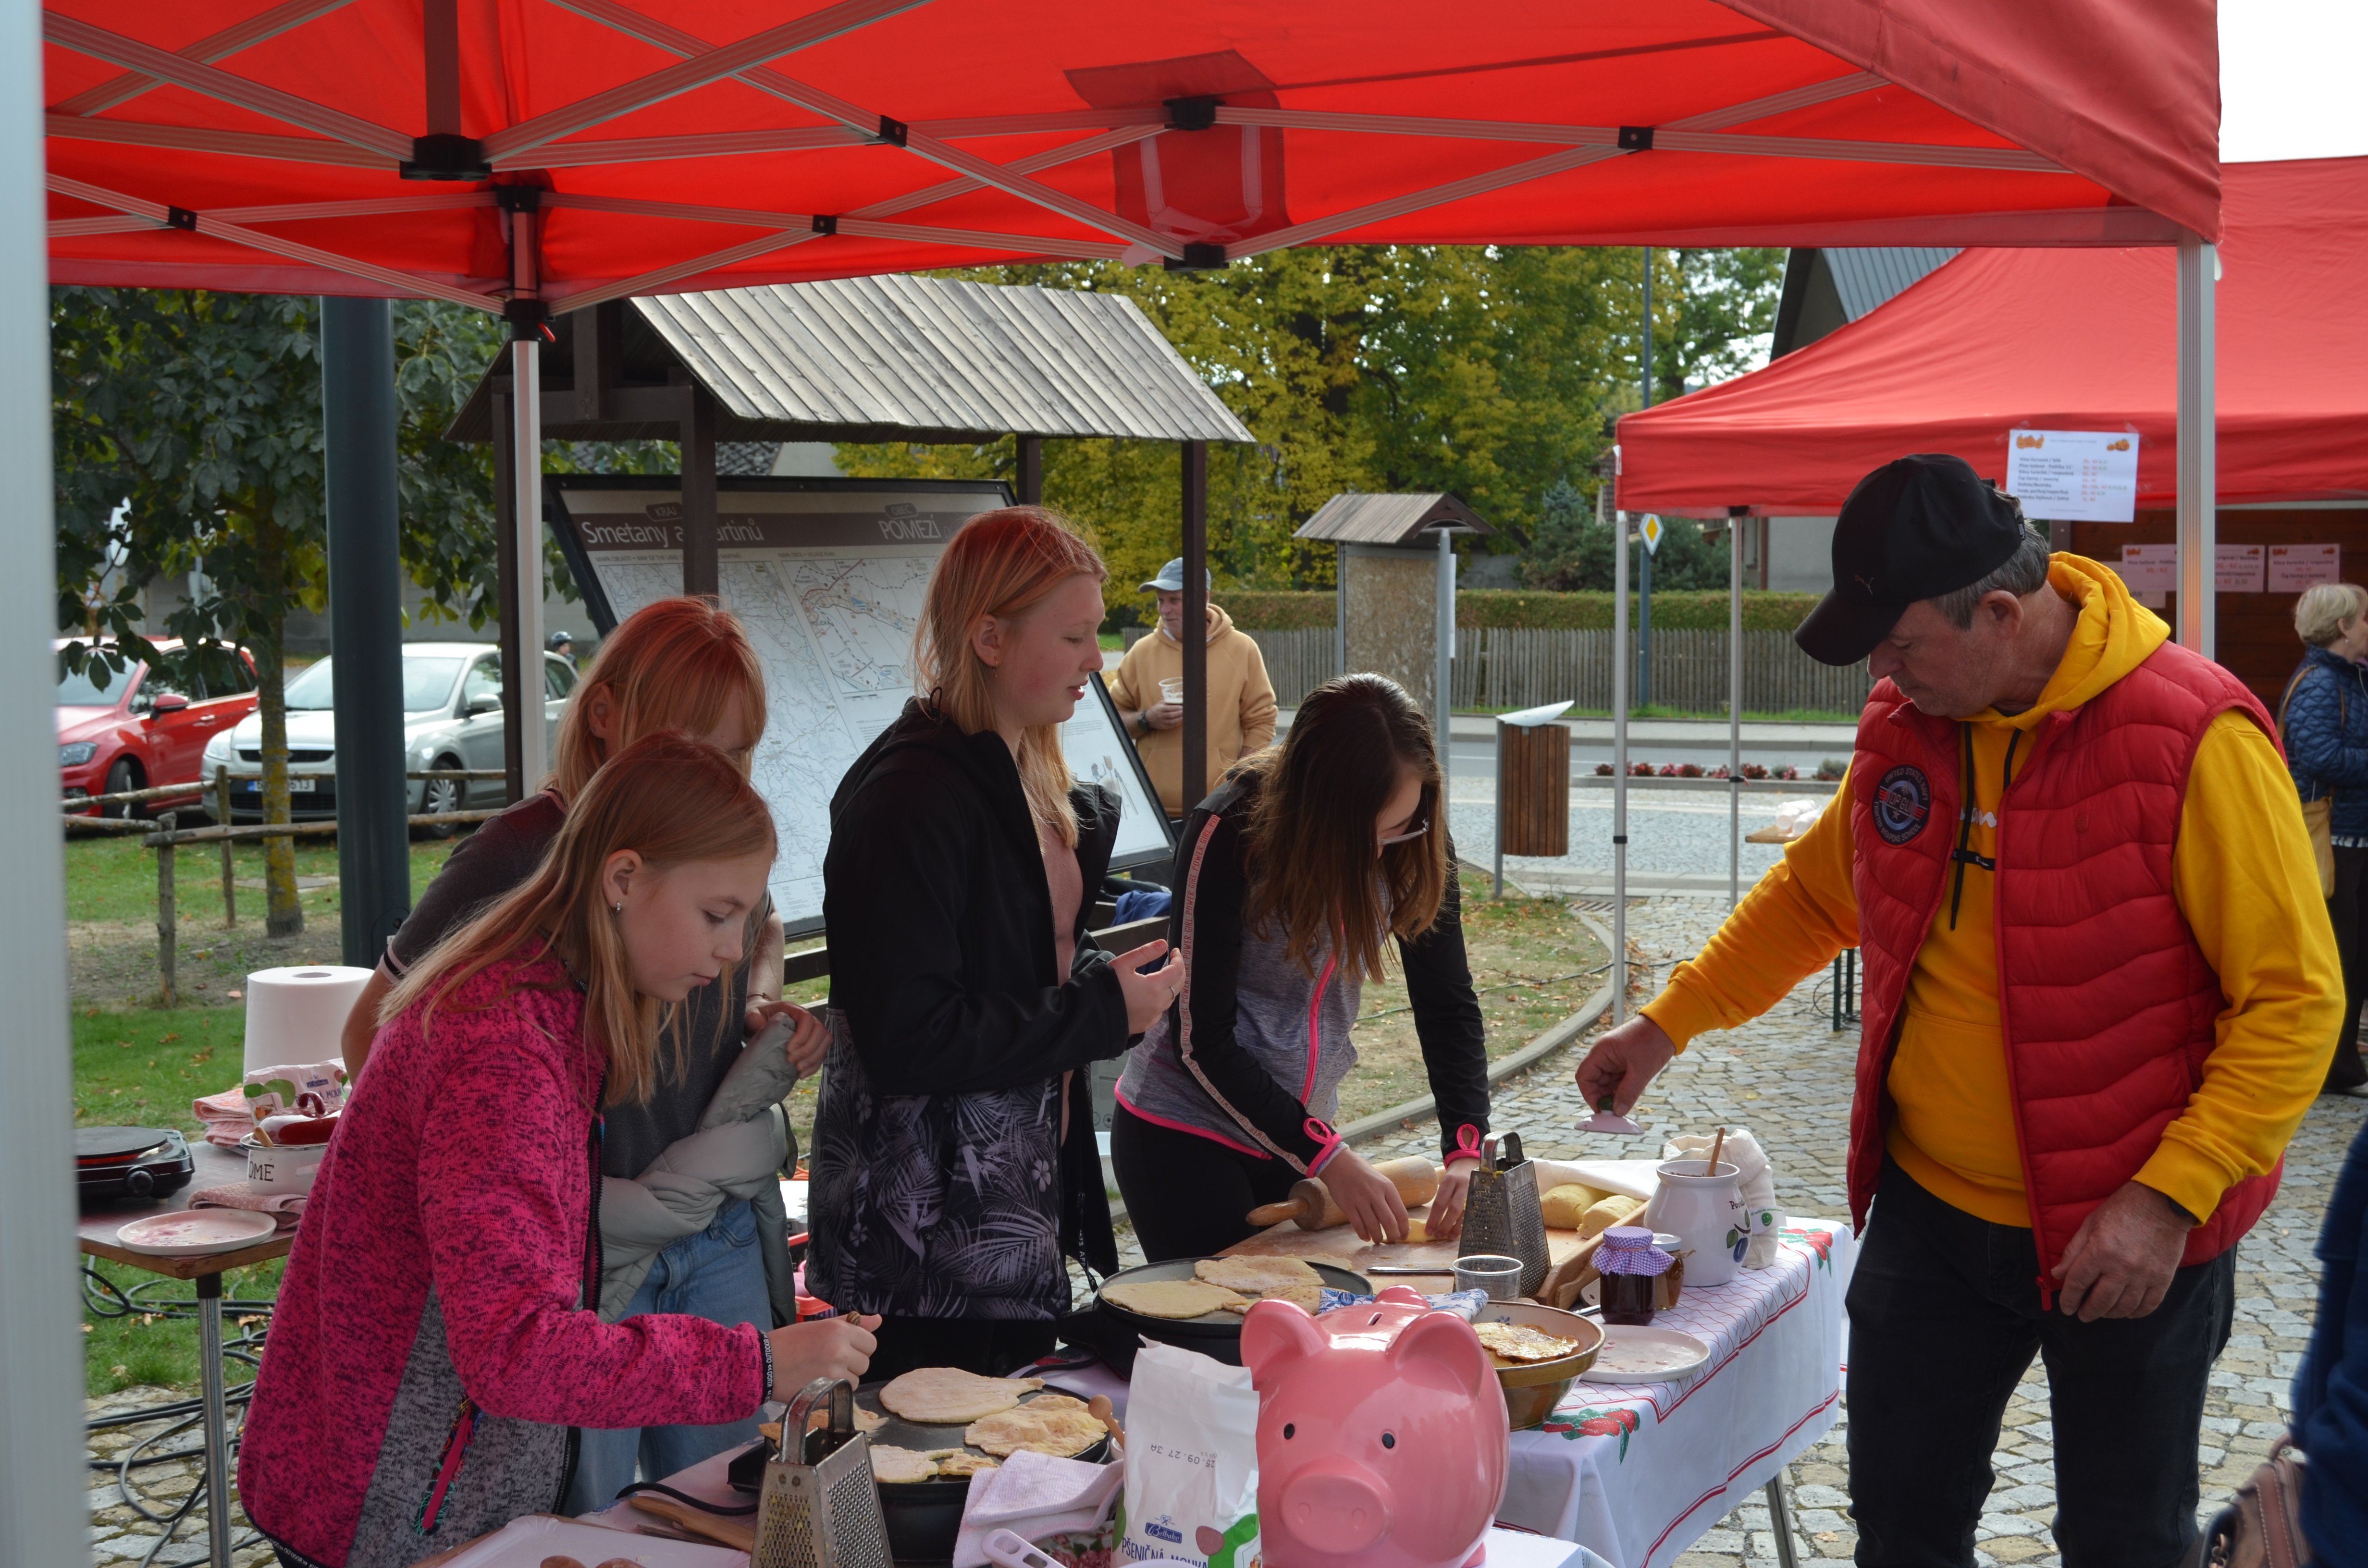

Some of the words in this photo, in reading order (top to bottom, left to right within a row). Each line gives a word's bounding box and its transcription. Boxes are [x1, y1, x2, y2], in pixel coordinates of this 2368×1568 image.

[654, 506, 677, 517] KRAJ
[891, 504, 912, 516] OBEC
[581, 521, 668, 548] Smetany
[716, 518, 765, 542] artinů
[878, 514, 942, 540] POMEZÍ
[1199, 829, 1211, 845] GIRL
[1193, 845, 1204, 871] POWER
[1188, 874, 1196, 889] GIRL
[1186, 891, 1195, 915] POWER
[1184, 919, 1193, 932] GIRL
[1183, 935, 1192, 960] POWER
[1182, 1023, 1190, 1046] POWER
[1188, 1061, 1205, 1082] POWER
[1205, 1083, 1217, 1095] GIRL
[1217, 1095, 1236, 1115] POWER
[1237, 1115, 1249, 1127] GIRL
[1249, 1127, 1270, 1145] POWER
[1286, 1153, 1306, 1172] POWER
[763, 1338, 772, 1364] OUTDOOR
[1150, 1444, 1163, 1455] 3A
[1168, 1449, 1216, 1469] 25.09.27
